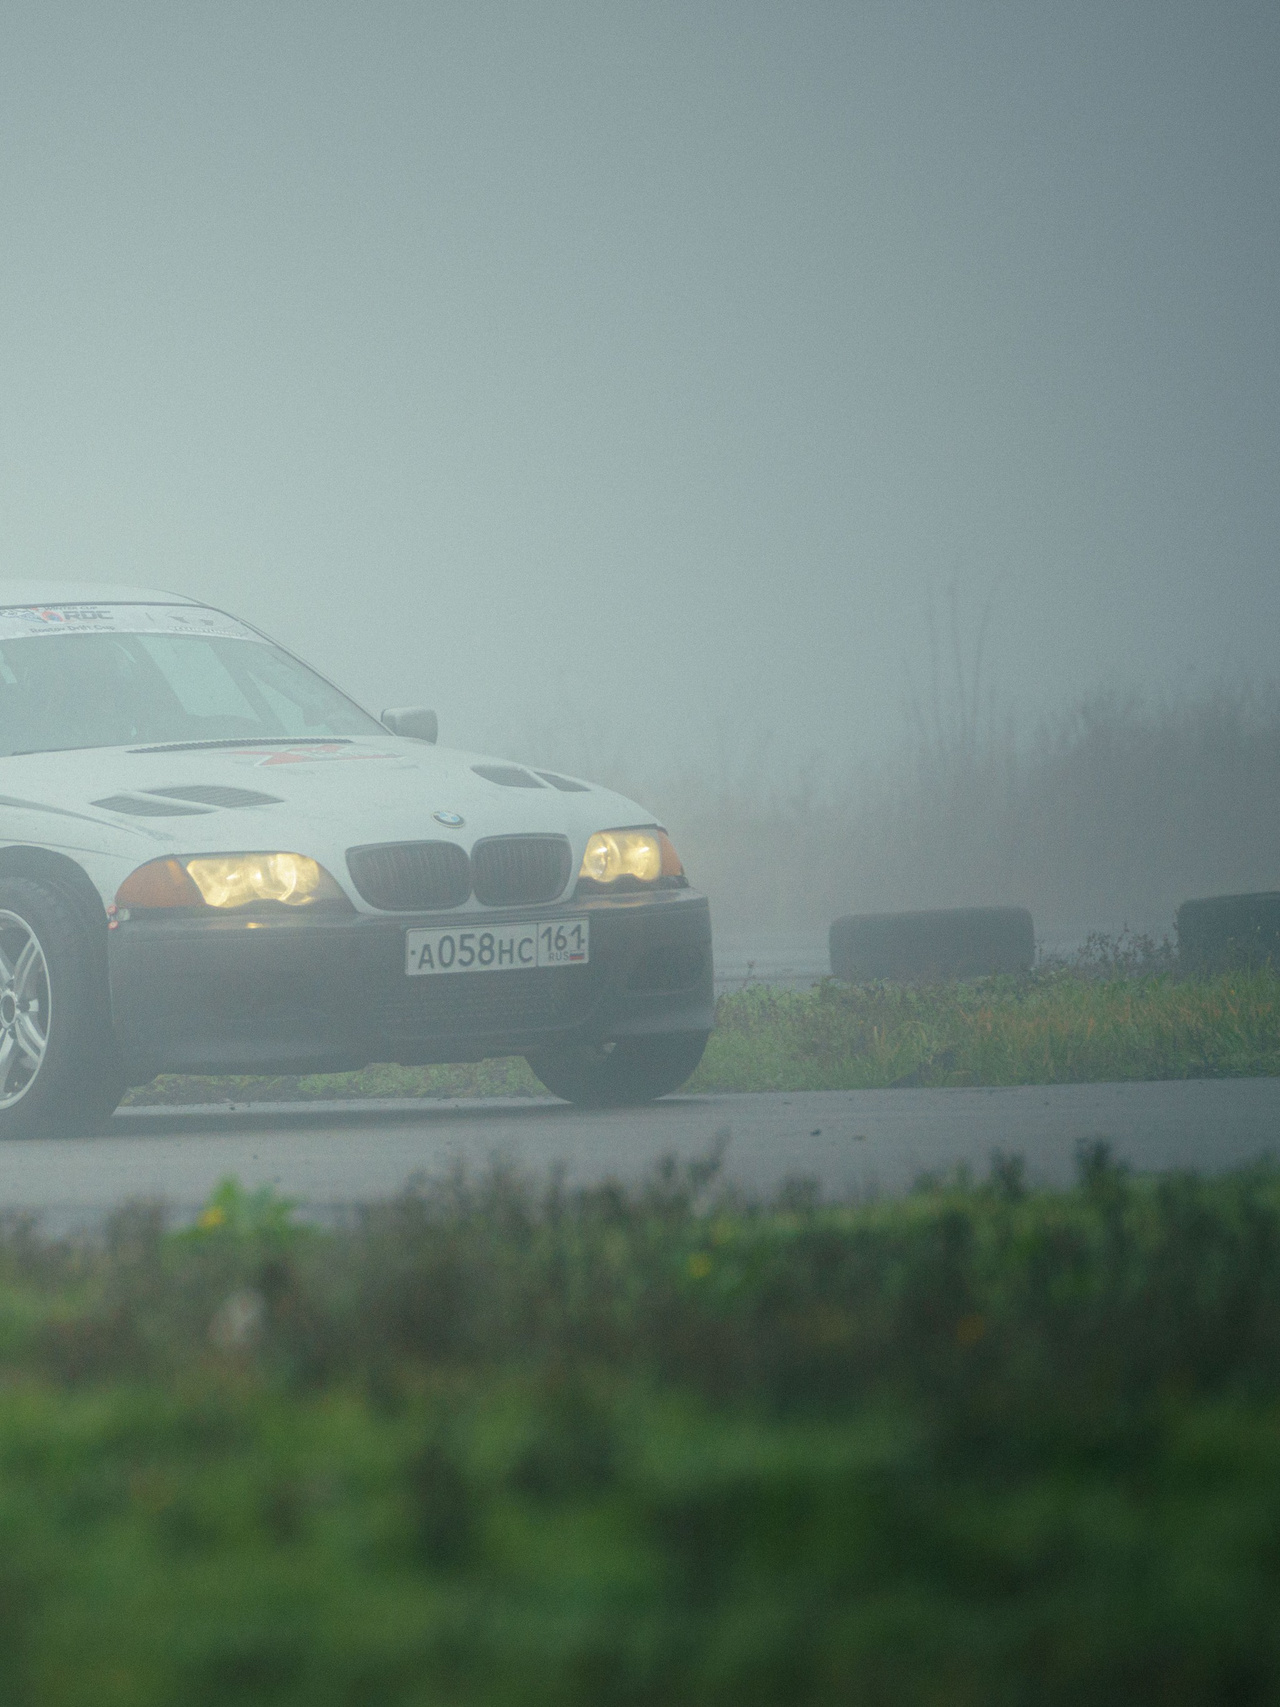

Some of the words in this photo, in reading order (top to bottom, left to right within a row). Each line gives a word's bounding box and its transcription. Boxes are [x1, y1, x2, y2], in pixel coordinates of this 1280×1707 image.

[63, 610, 114, 620] RDC
[418, 932, 534, 969] А058НС
[540, 923, 583, 951] 161
[548, 951, 569, 962] RUS
